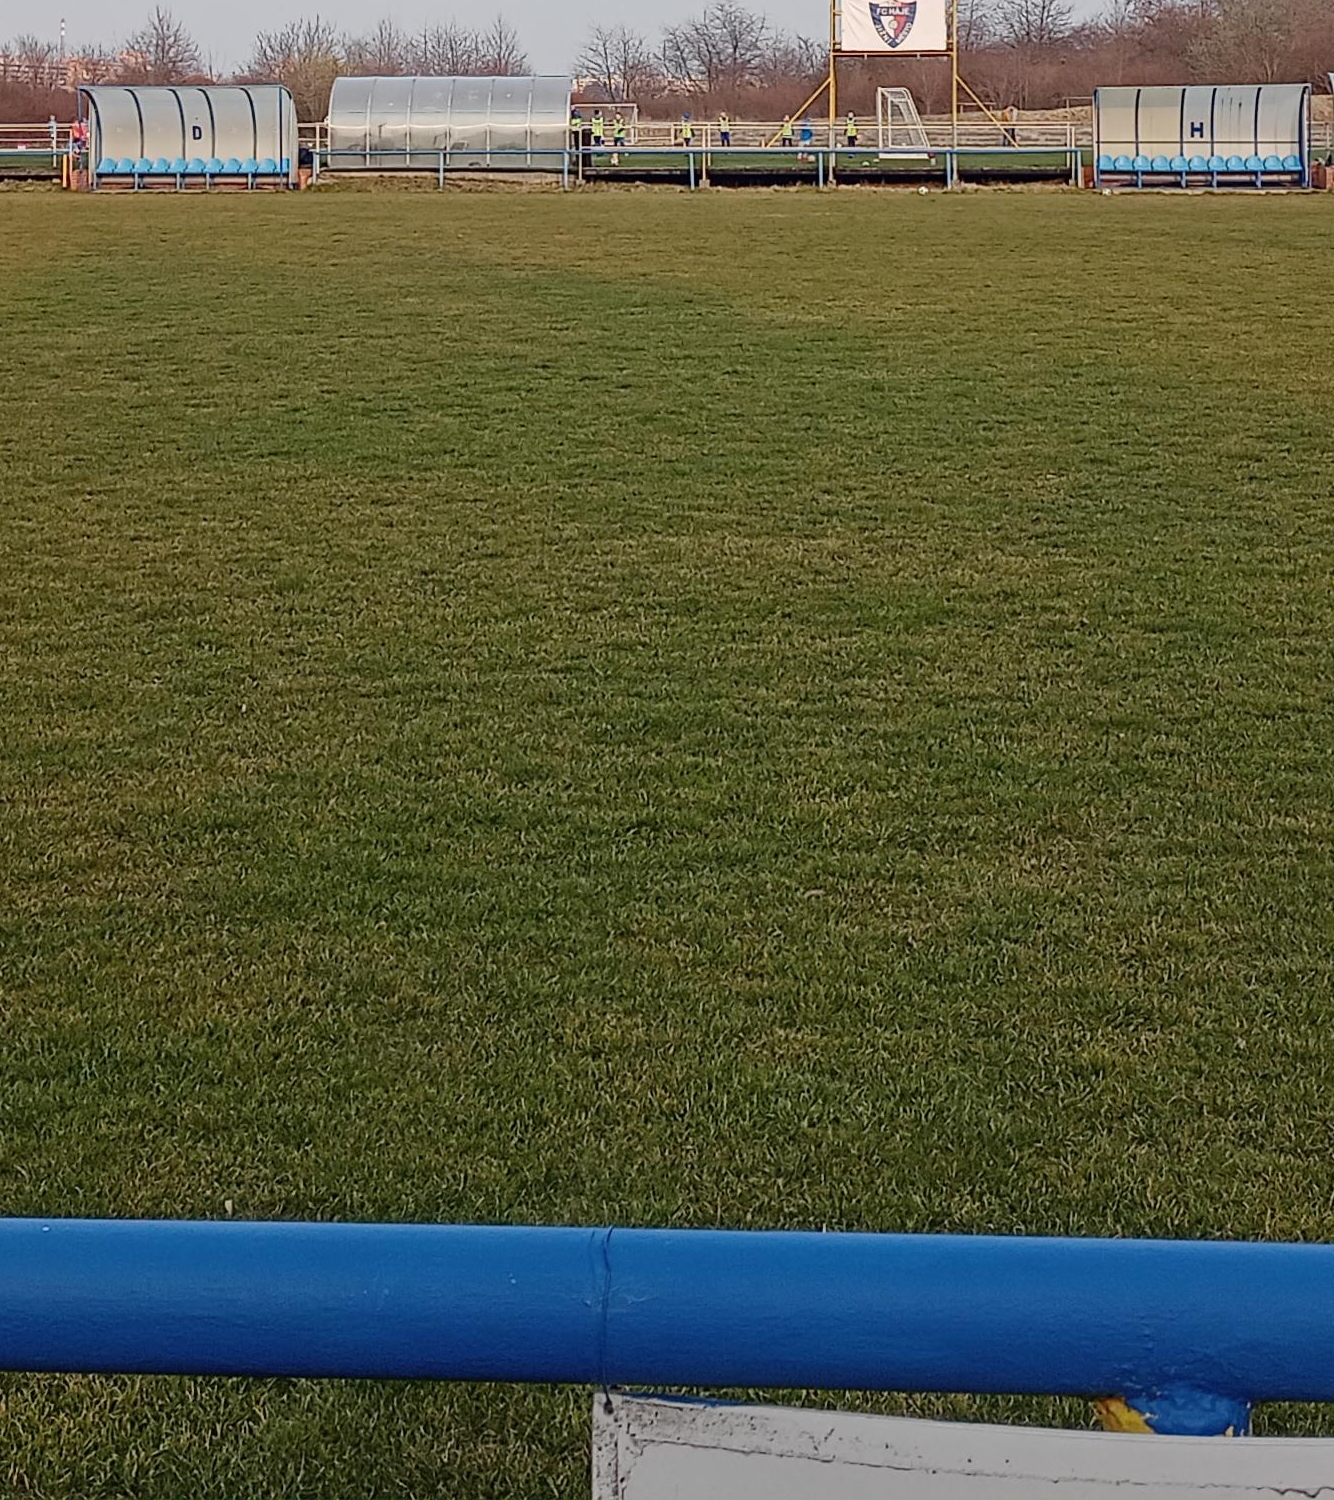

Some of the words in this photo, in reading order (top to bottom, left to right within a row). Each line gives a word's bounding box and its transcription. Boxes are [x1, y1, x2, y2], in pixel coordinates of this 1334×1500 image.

[876, 7, 888, 16] FC
[192, 125, 202, 141] D
[1190, 121, 1204, 139] H
